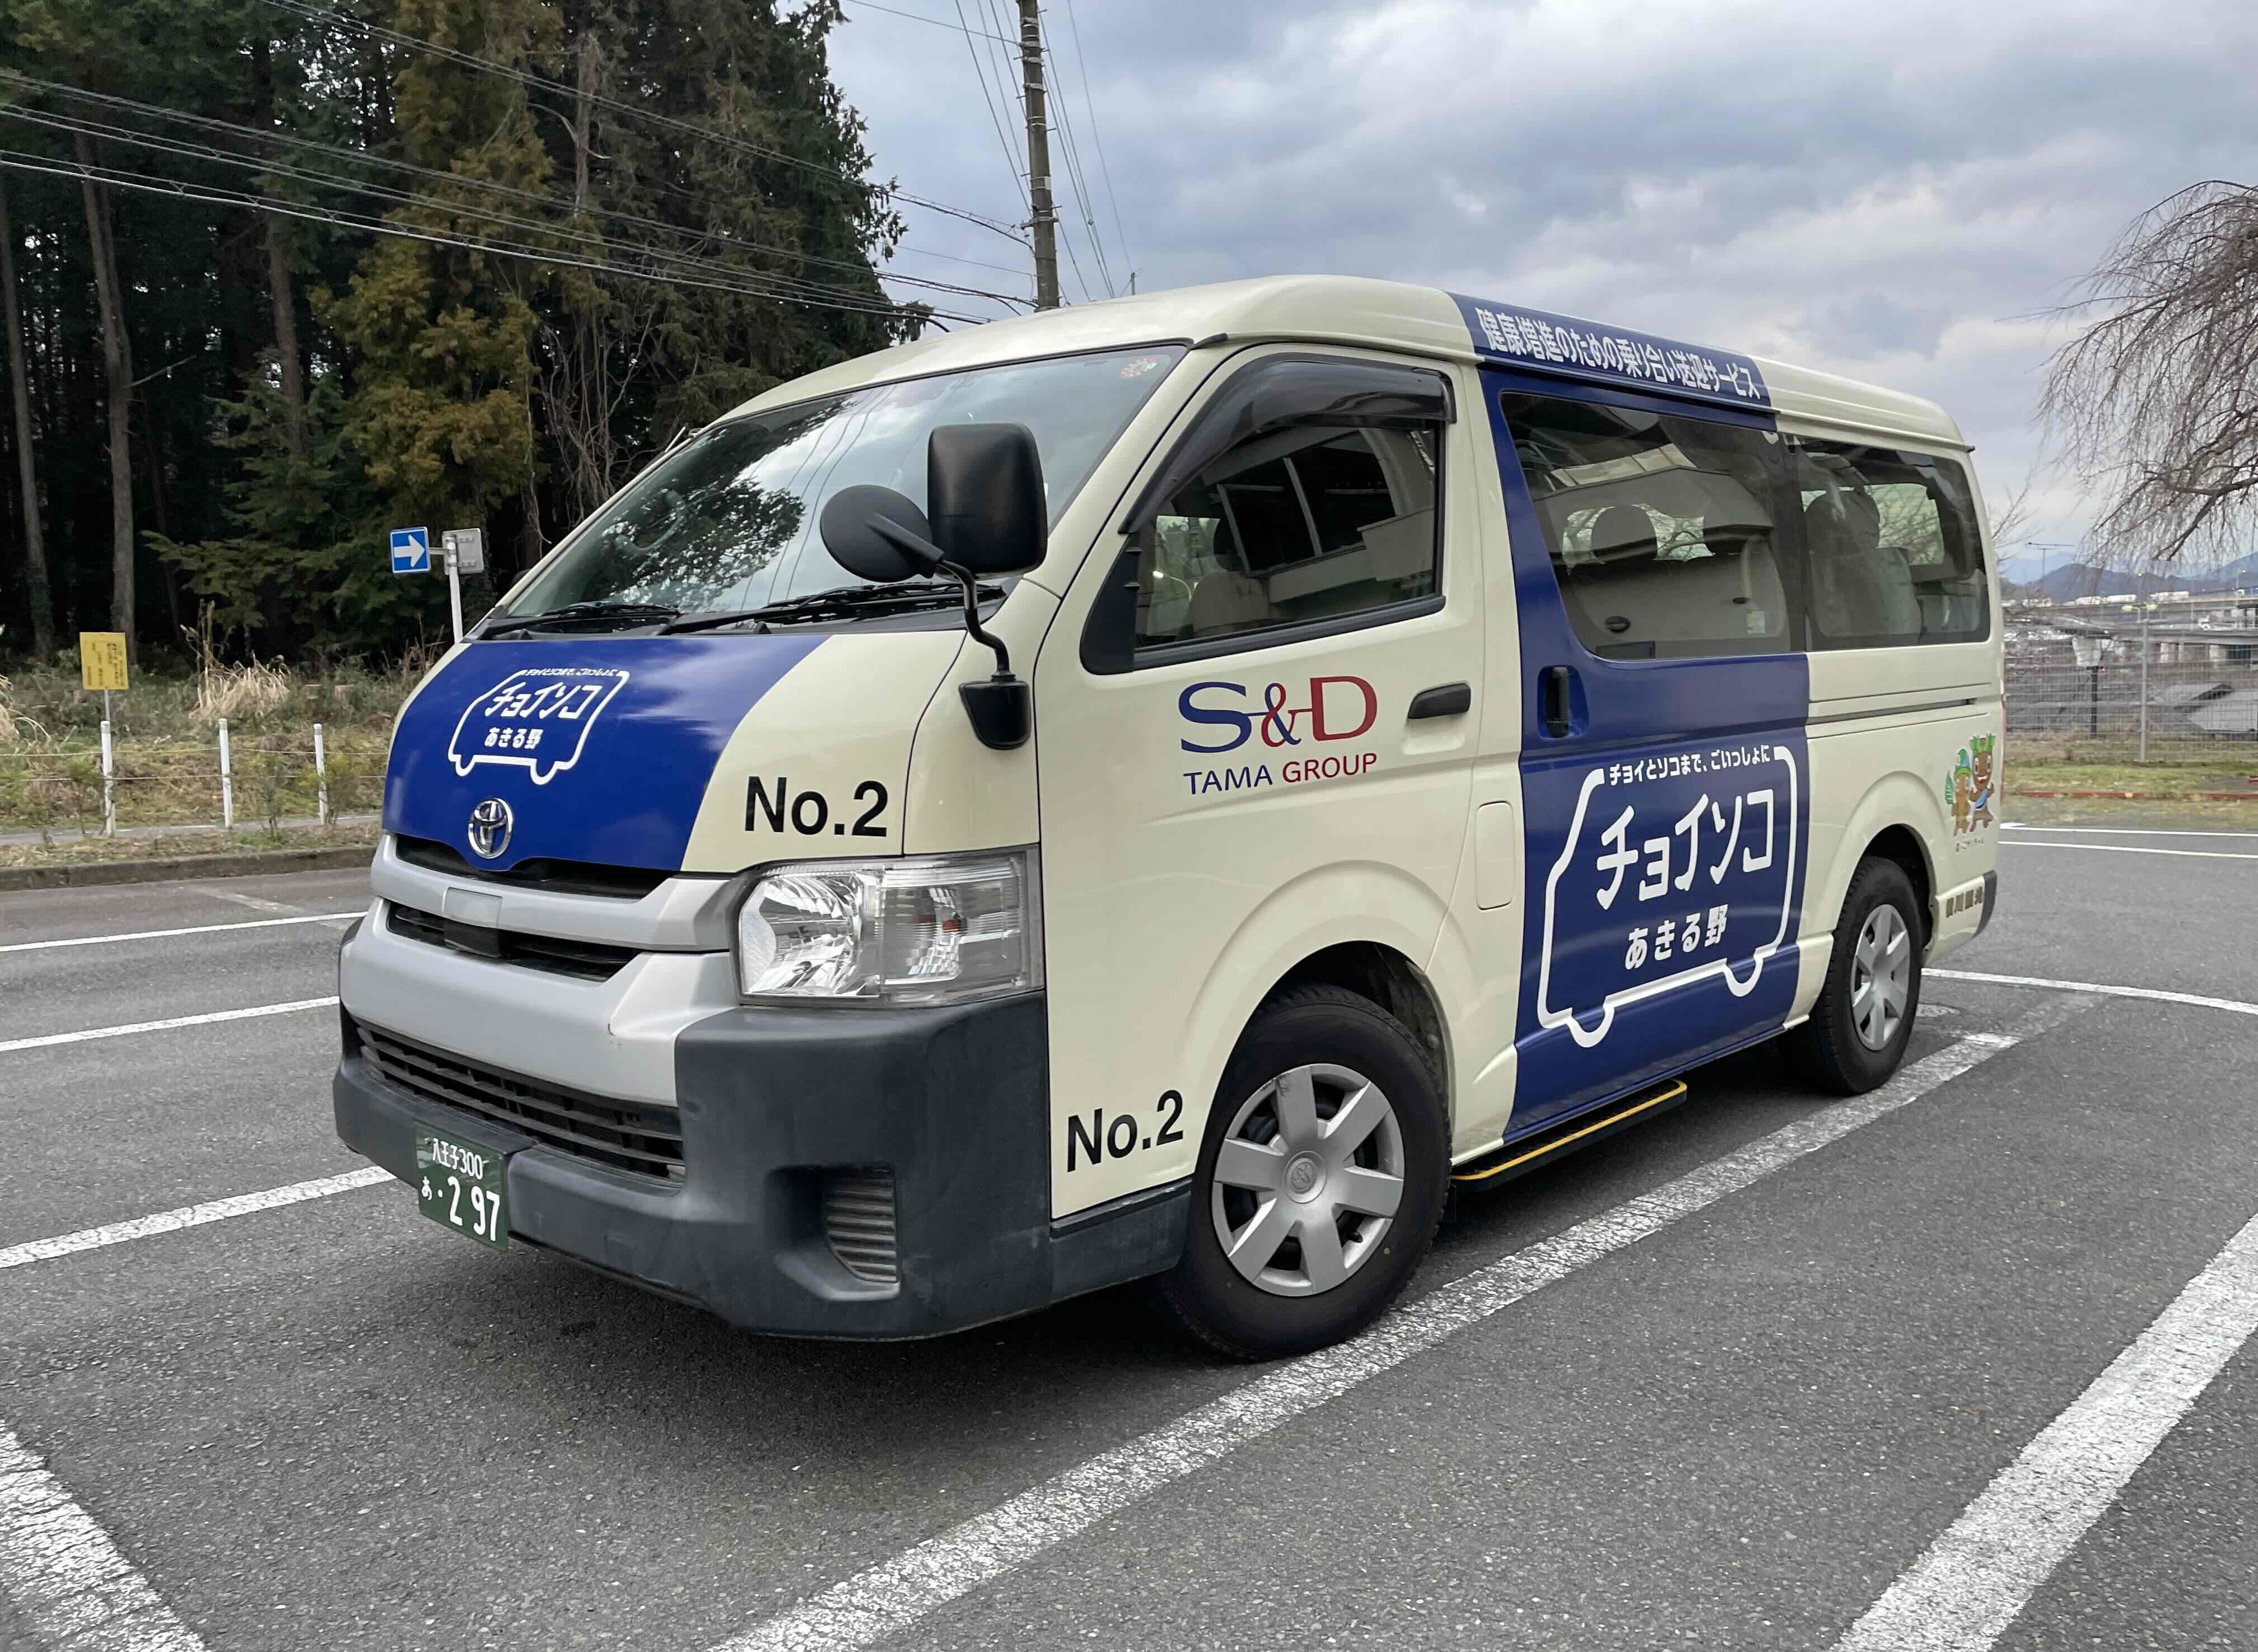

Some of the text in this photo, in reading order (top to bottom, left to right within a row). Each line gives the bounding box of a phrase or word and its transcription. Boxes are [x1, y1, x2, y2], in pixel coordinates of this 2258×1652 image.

[1475, 307, 1761, 400] 健康増進のための乗り合い送迎サービス
[484, 682, 603, 719] チョイソコ
[1178, 675, 1378, 753] S&D
[484, 727, 544, 750] あきる野
[1609, 744, 1770, 786] チョイとソコまで、ごいっしょに
[745, 775, 888, 837] No.2
[1183, 753, 1378, 795] TAMA GROUP
[1596, 788, 1774, 910] チョイソコ
[1625, 904, 1729, 970] あきる野
[1067, 1089, 1184, 1172] No.2
